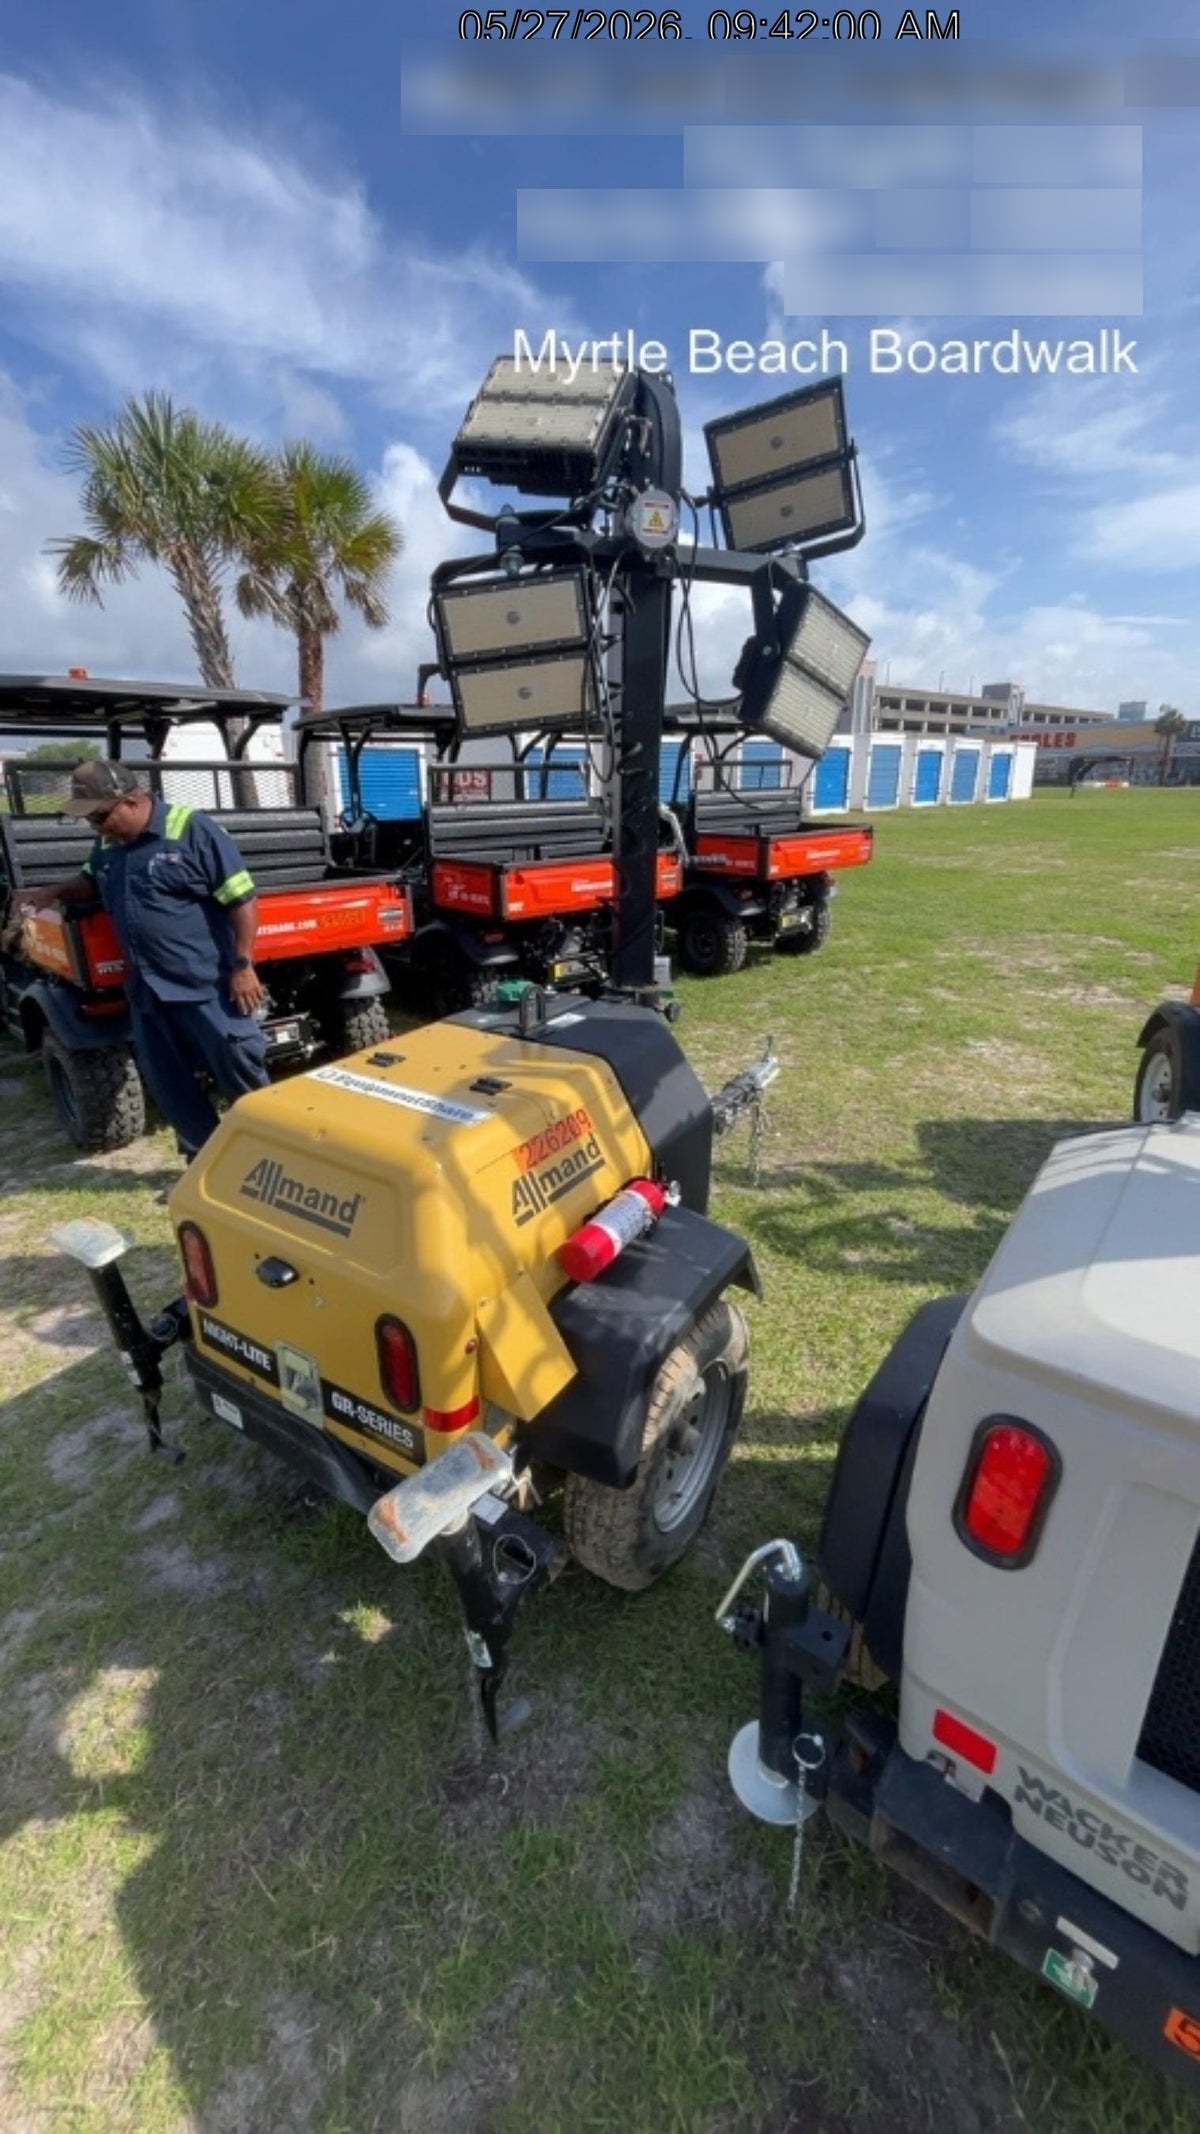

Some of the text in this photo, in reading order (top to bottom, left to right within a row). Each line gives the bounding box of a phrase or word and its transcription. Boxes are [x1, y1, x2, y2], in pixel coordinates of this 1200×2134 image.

[241, 1158, 362, 1225] Allmand
[512, 1132, 603, 1215] Allmand
[331, 1391, 414, 1449] GR-SERIES
[1014, 1784, 1188, 1912] NEUSON
[1017, 1765, 1189, 1888] WACKER
